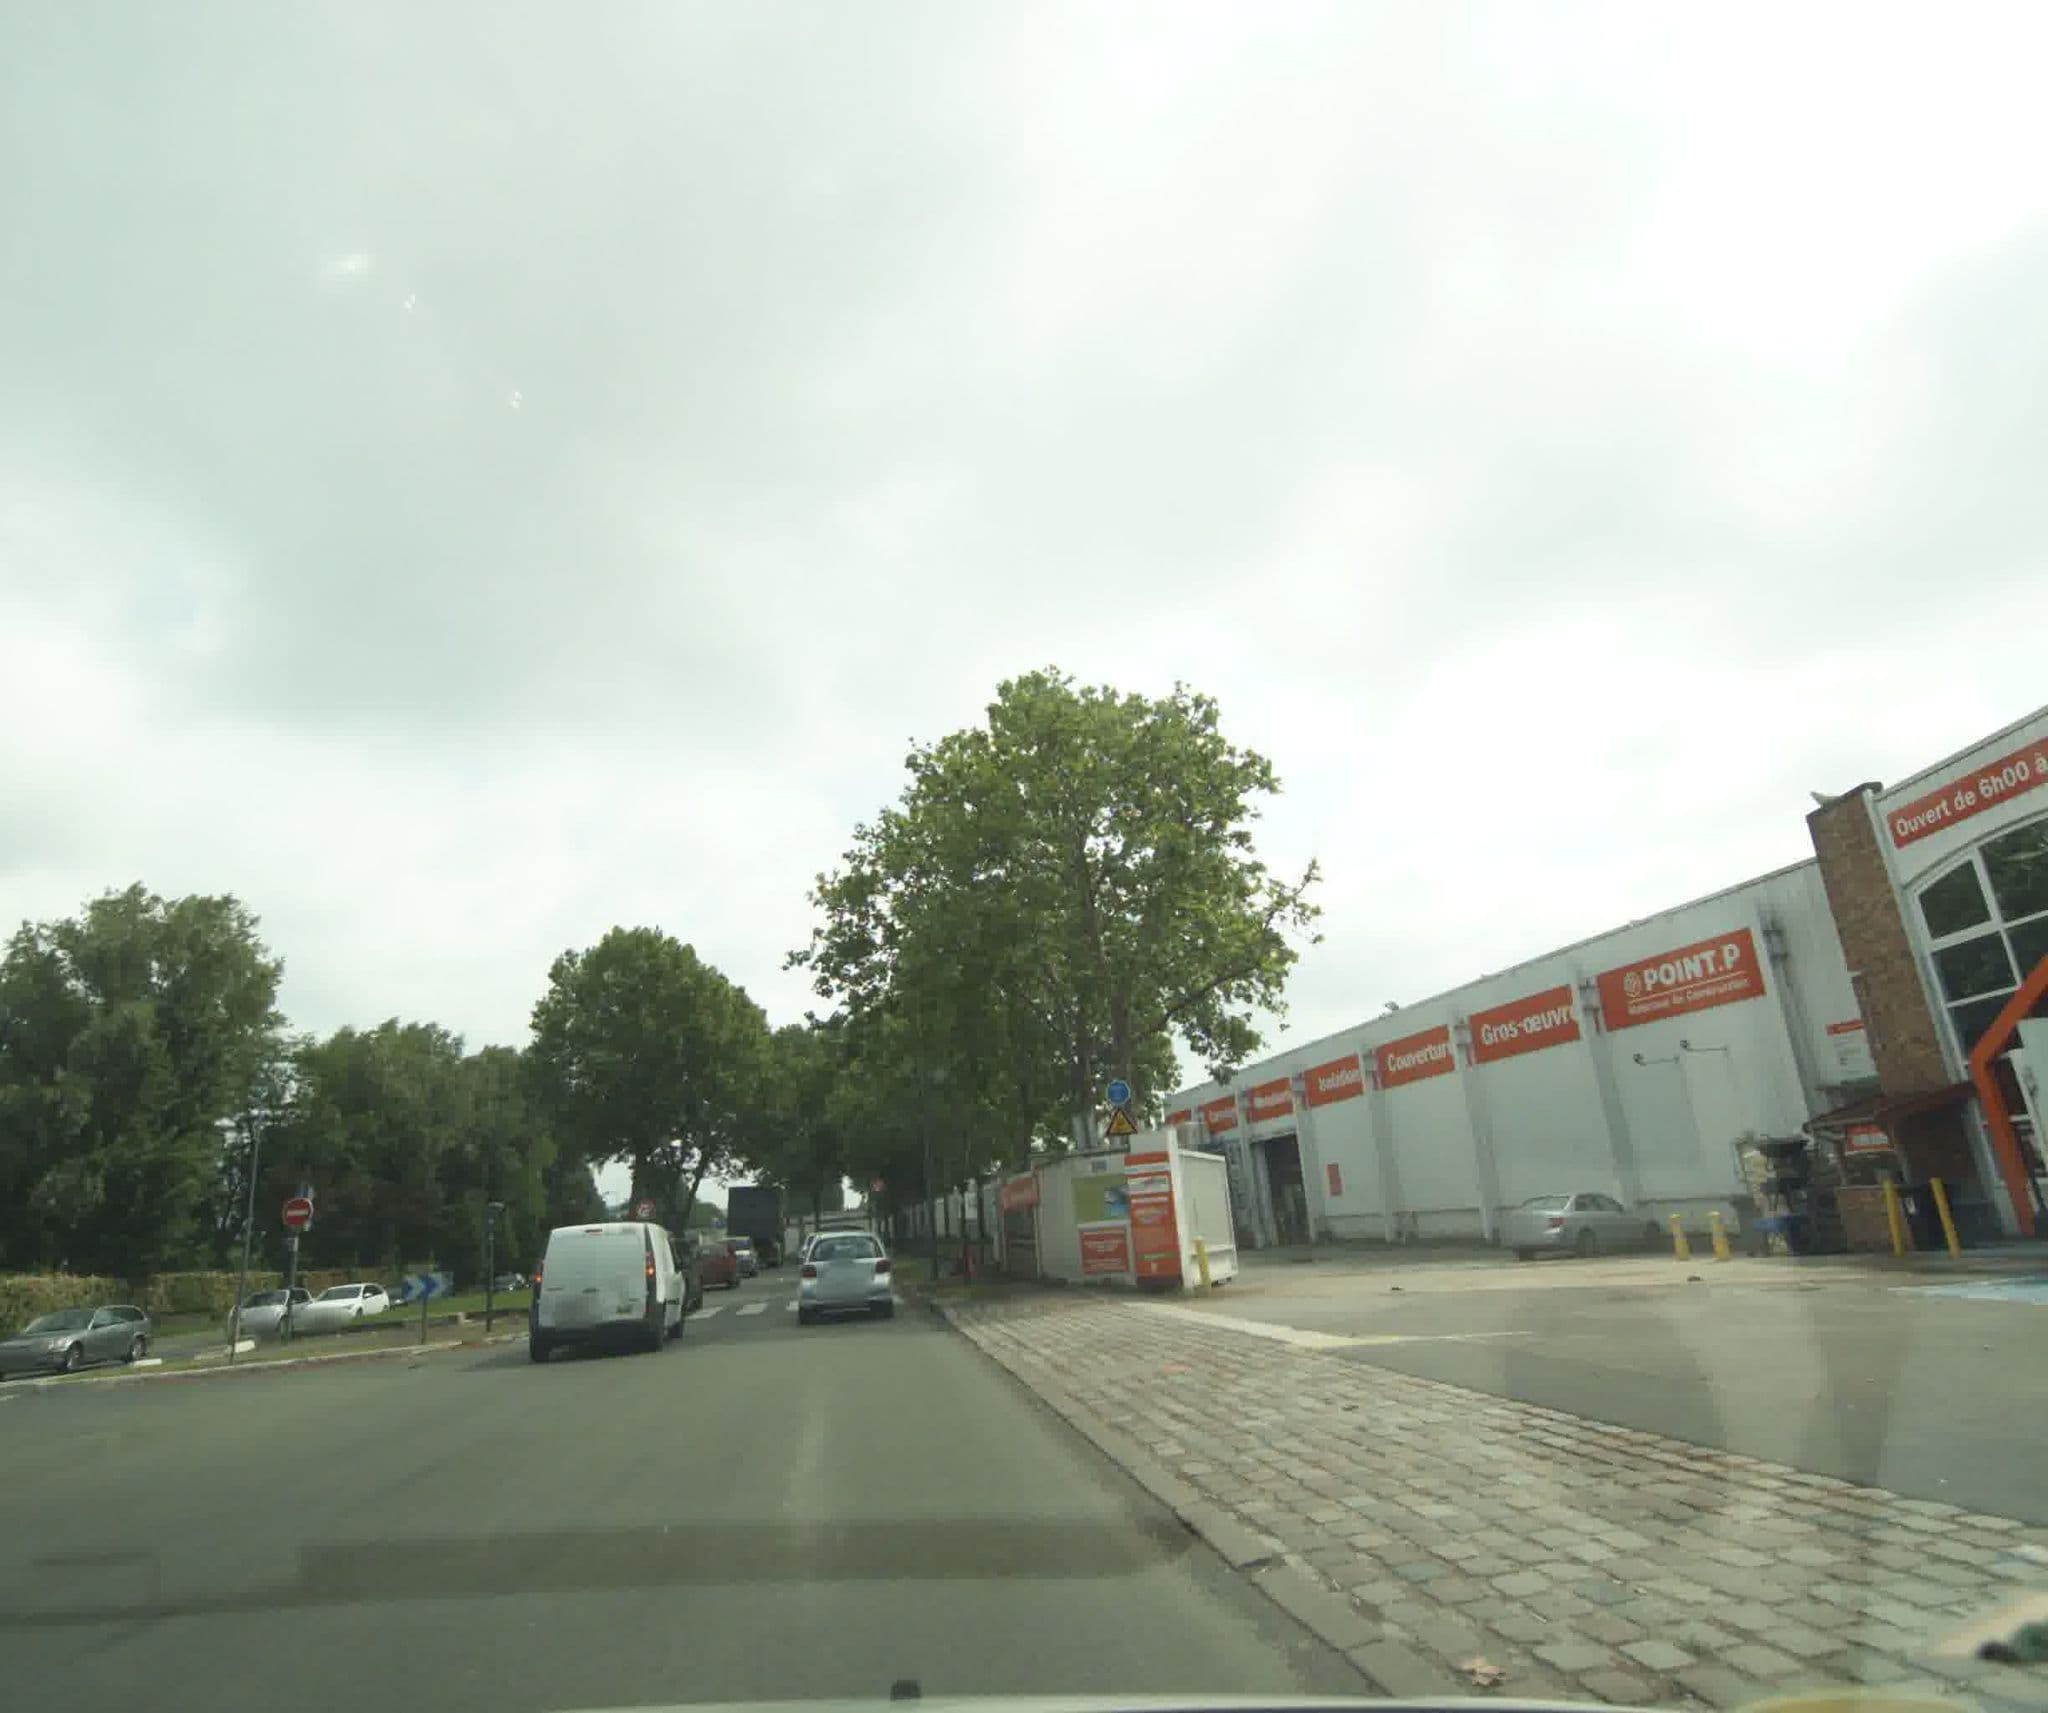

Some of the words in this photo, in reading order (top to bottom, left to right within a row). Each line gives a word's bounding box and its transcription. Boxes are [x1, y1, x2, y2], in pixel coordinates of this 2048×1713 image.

[1896, 799, 1951, 837] Ouvert
[1954, 790, 1976, 811] de
[1978, 760, 2030, 798] 6h00
